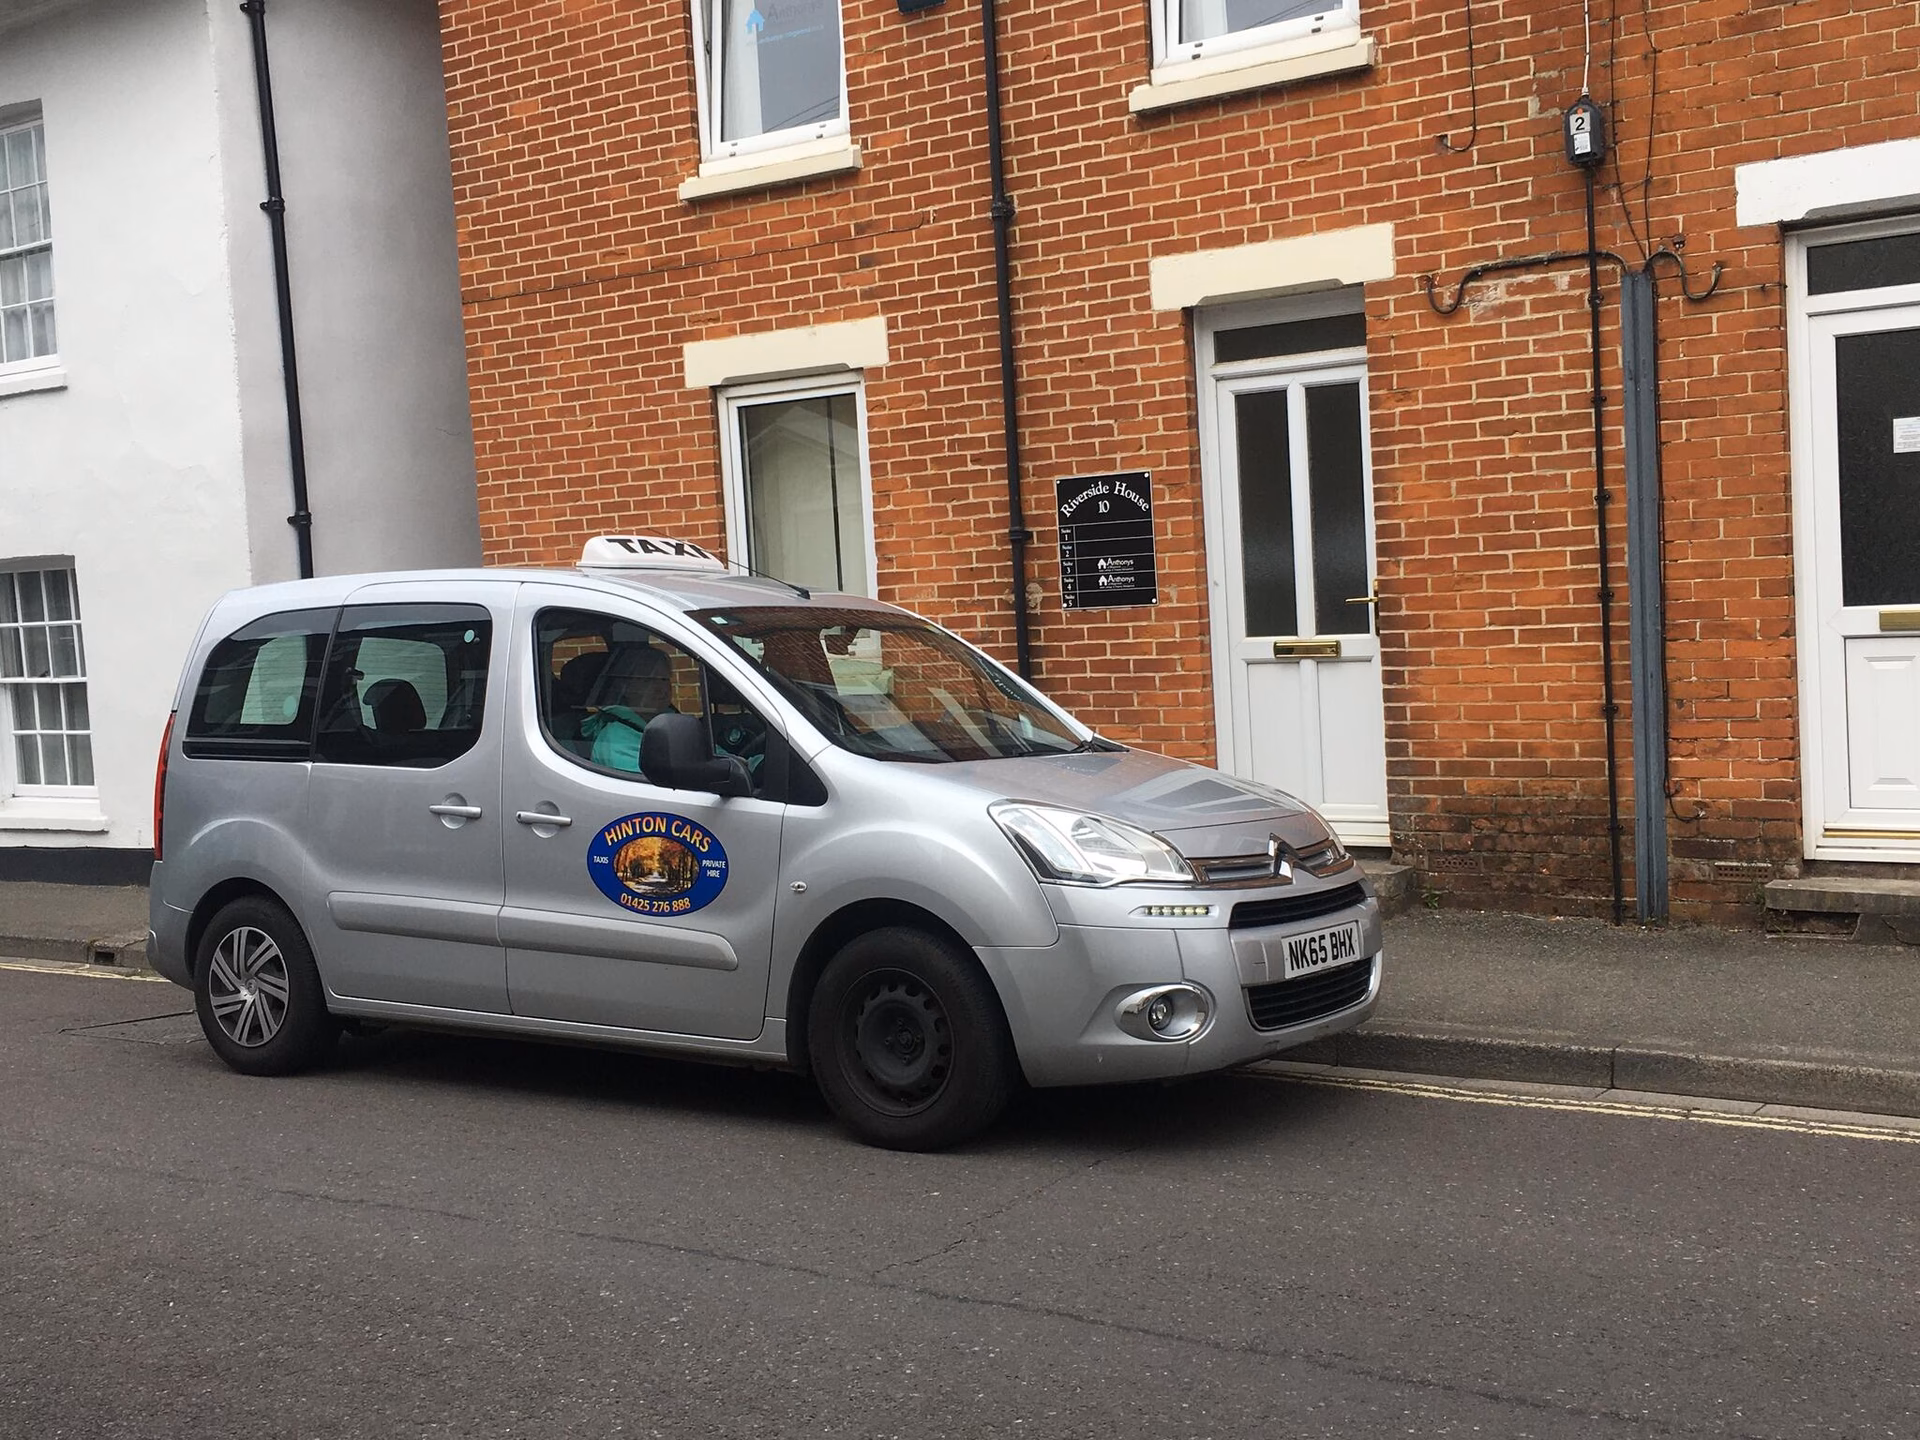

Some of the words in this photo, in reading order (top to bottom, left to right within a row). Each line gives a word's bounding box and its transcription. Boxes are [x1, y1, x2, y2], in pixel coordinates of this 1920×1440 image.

[1575, 116, 1586, 131] 2
[1060, 481, 1110, 518] Riverside
[1114, 481, 1149, 511] House
[1098, 500, 1110, 513] 10
[606, 538, 711, 559] TAXI
[604, 816, 667, 846] HINTON
[671, 821, 711, 852] CARS
[593, 856, 609, 864] TAXIS
[702, 860, 726, 869] PRIVATE
[706, 870, 720, 878] HIRE
[620, 893, 650, 911] 01425
[652, 901, 670, 912] 276
[671, 897, 691, 912] 888
[1288, 934, 1327, 971] NK65
[1329, 928, 1355, 960] BHX
